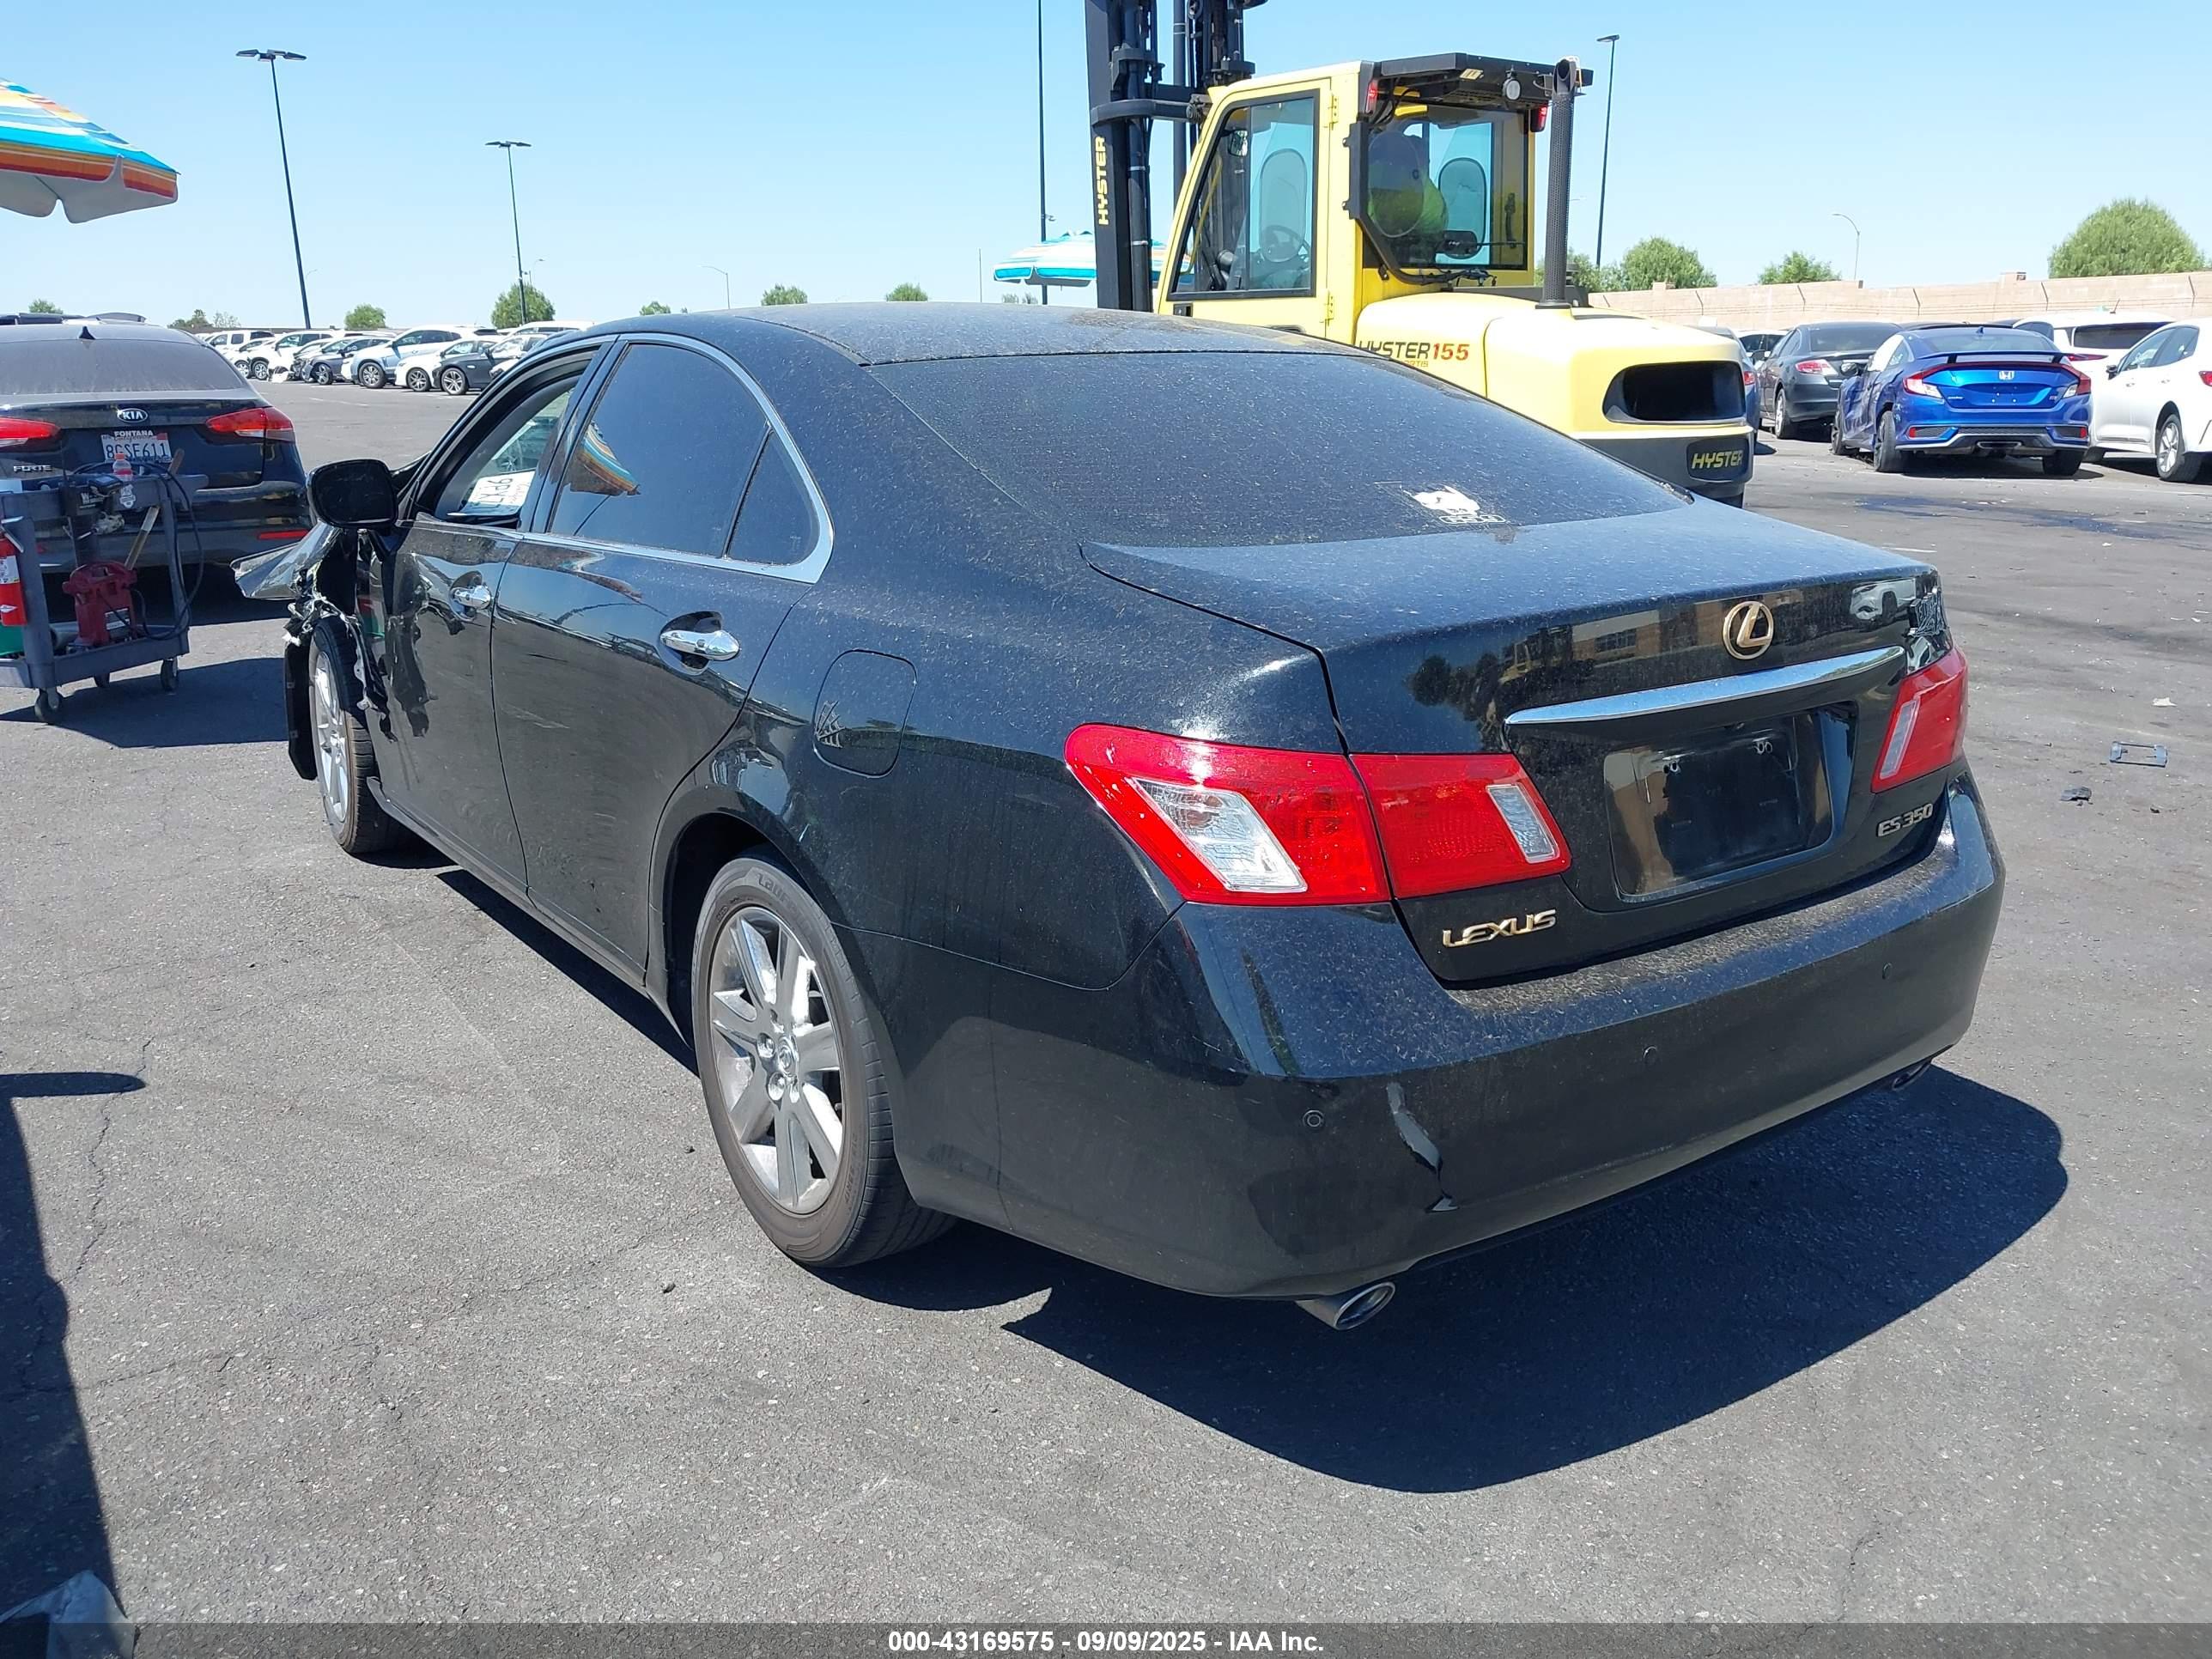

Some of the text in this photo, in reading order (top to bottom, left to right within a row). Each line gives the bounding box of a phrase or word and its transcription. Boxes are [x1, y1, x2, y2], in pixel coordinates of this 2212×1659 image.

[1096, 137, 1109, 225] HYSTER
[1433, 343, 1469, 361] 155
[123, 410, 143, 420] KIA
[1691, 450, 1743, 469] HYSTER
[1878, 803, 1933, 836] ES 350
[1443, 909, 1556, 947] LEXUS
